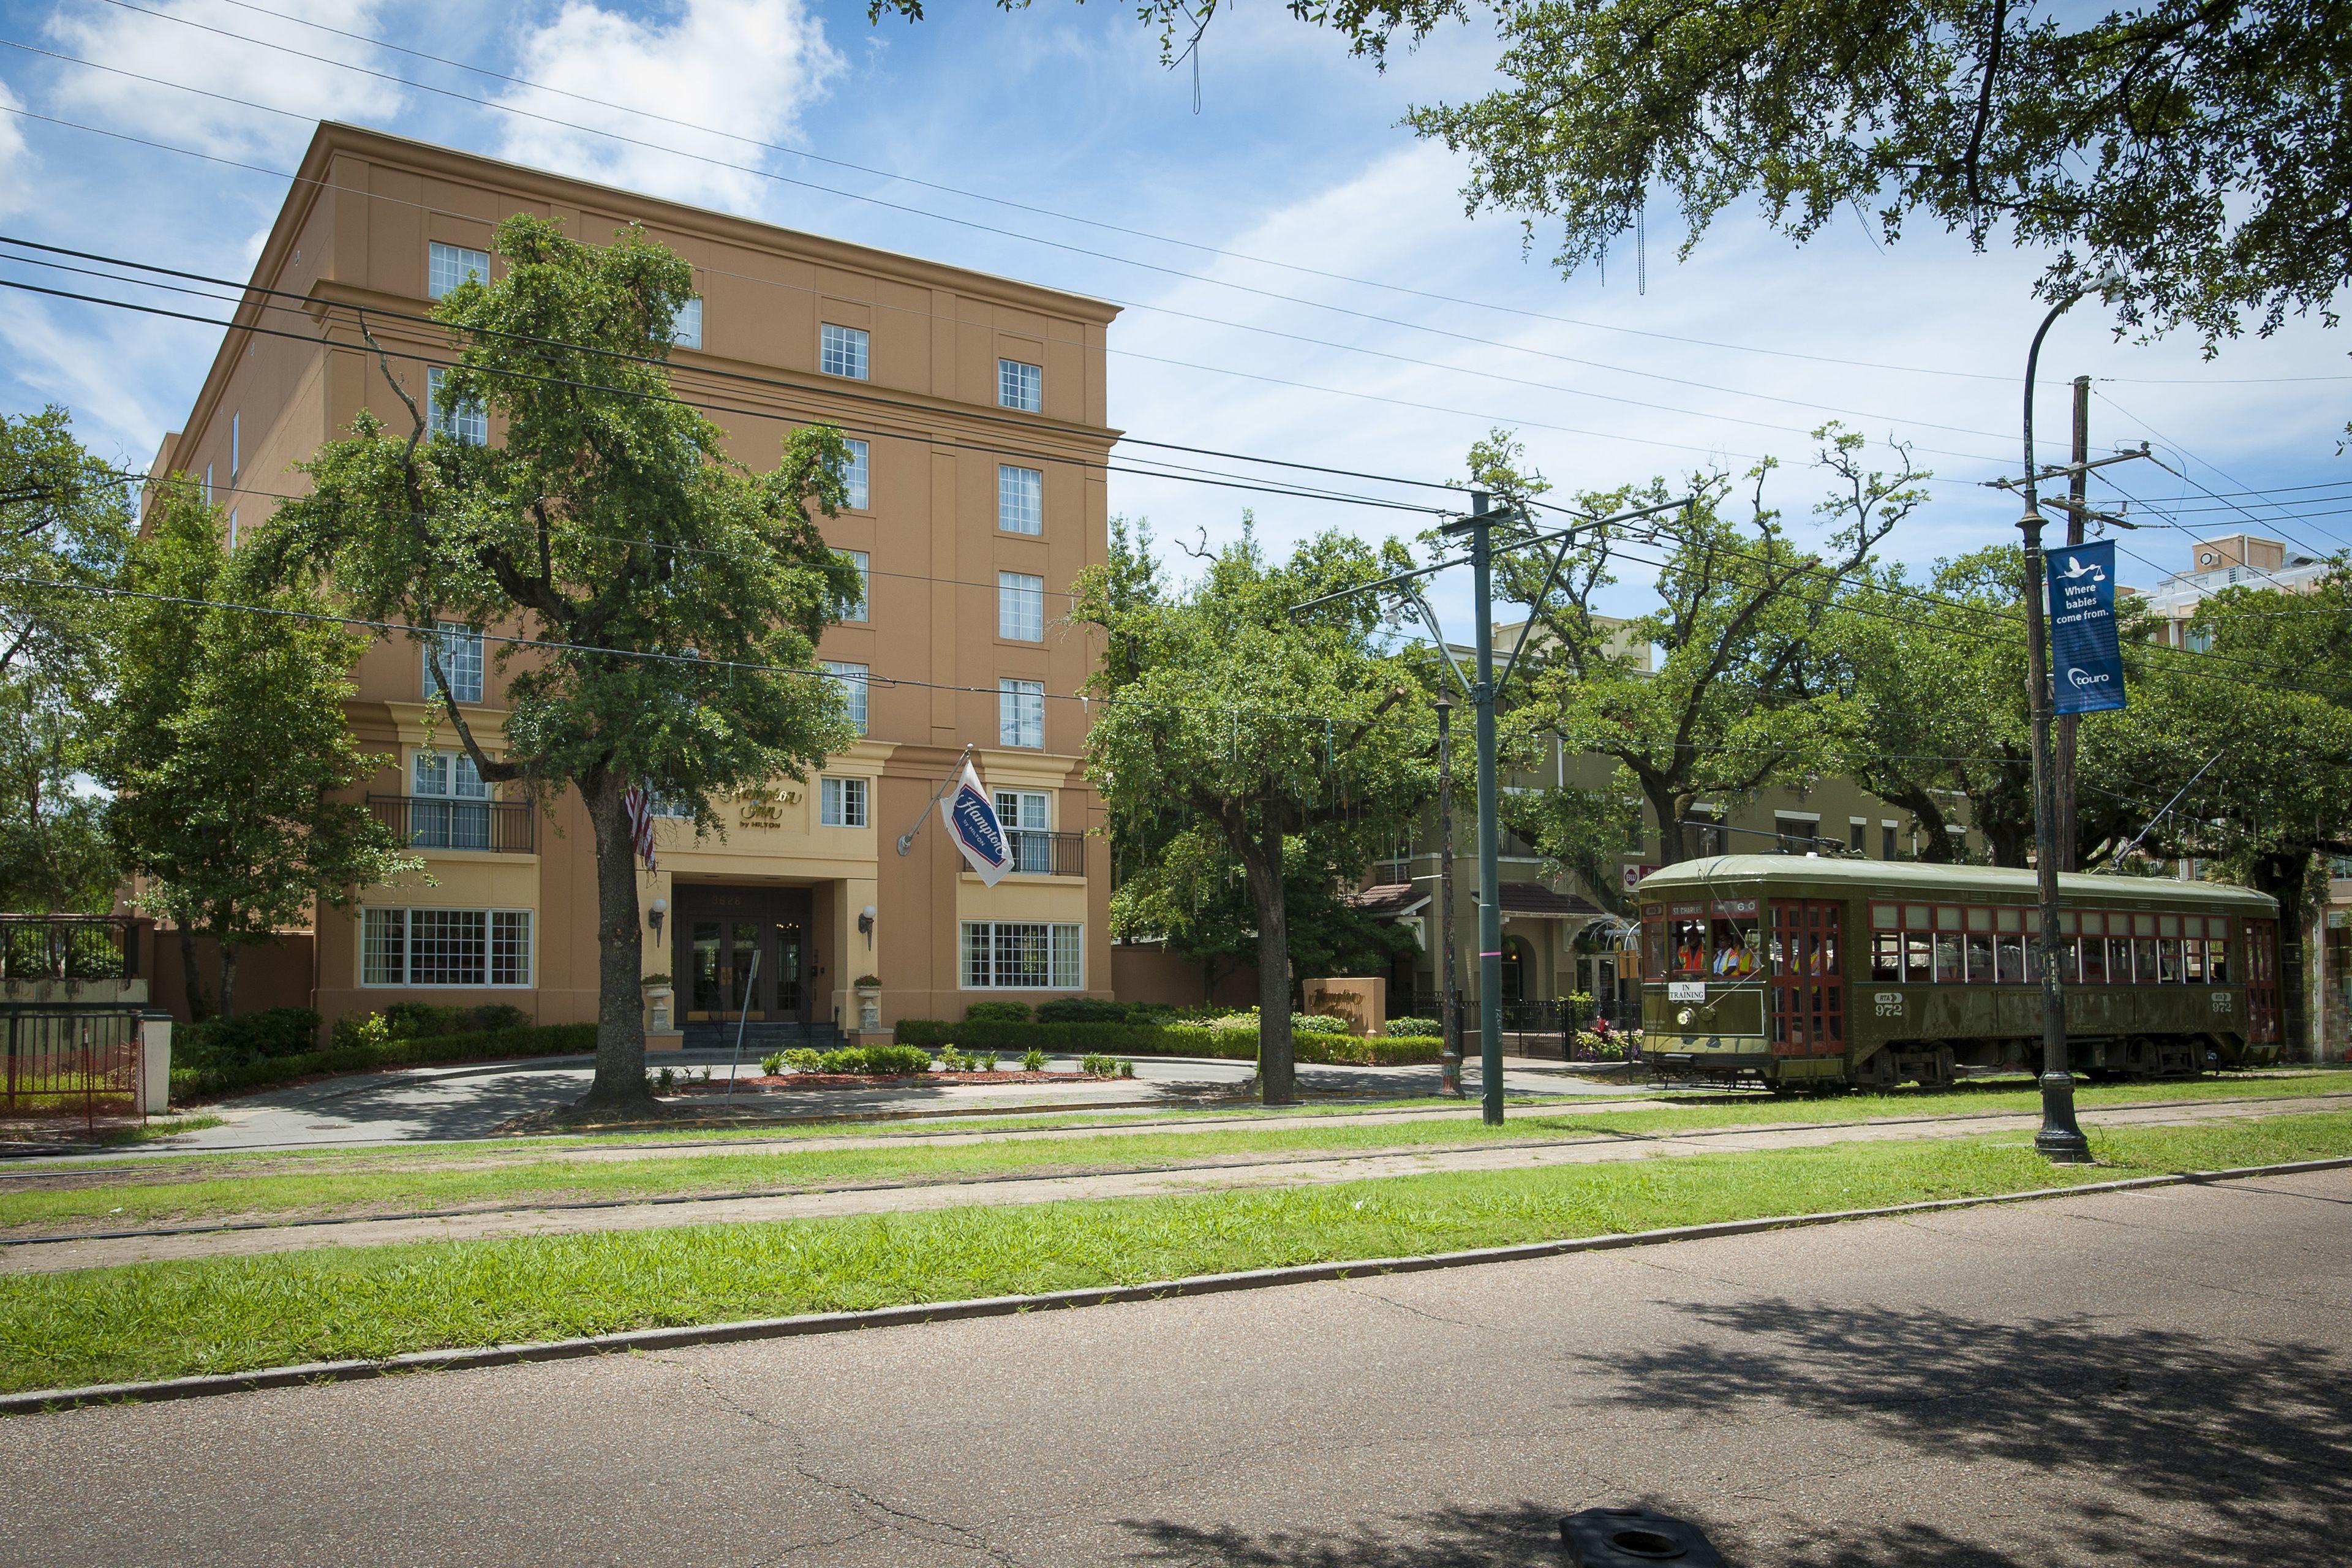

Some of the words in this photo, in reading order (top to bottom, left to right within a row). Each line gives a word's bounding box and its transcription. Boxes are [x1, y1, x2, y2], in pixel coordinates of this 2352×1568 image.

[2065, 584, 2096, 596] Where
[2066, 597, 2097, 609] babies
[2057, 614, 2082, 624] come
[2084, 609, 2108, 620] from.
[2075, 674, 2109, 685] touro
[969, 826, 985, 846] HILTON
[1875, 1005, 1902, 1016] 972
[2212, 1002, 2231, 1012] 972
